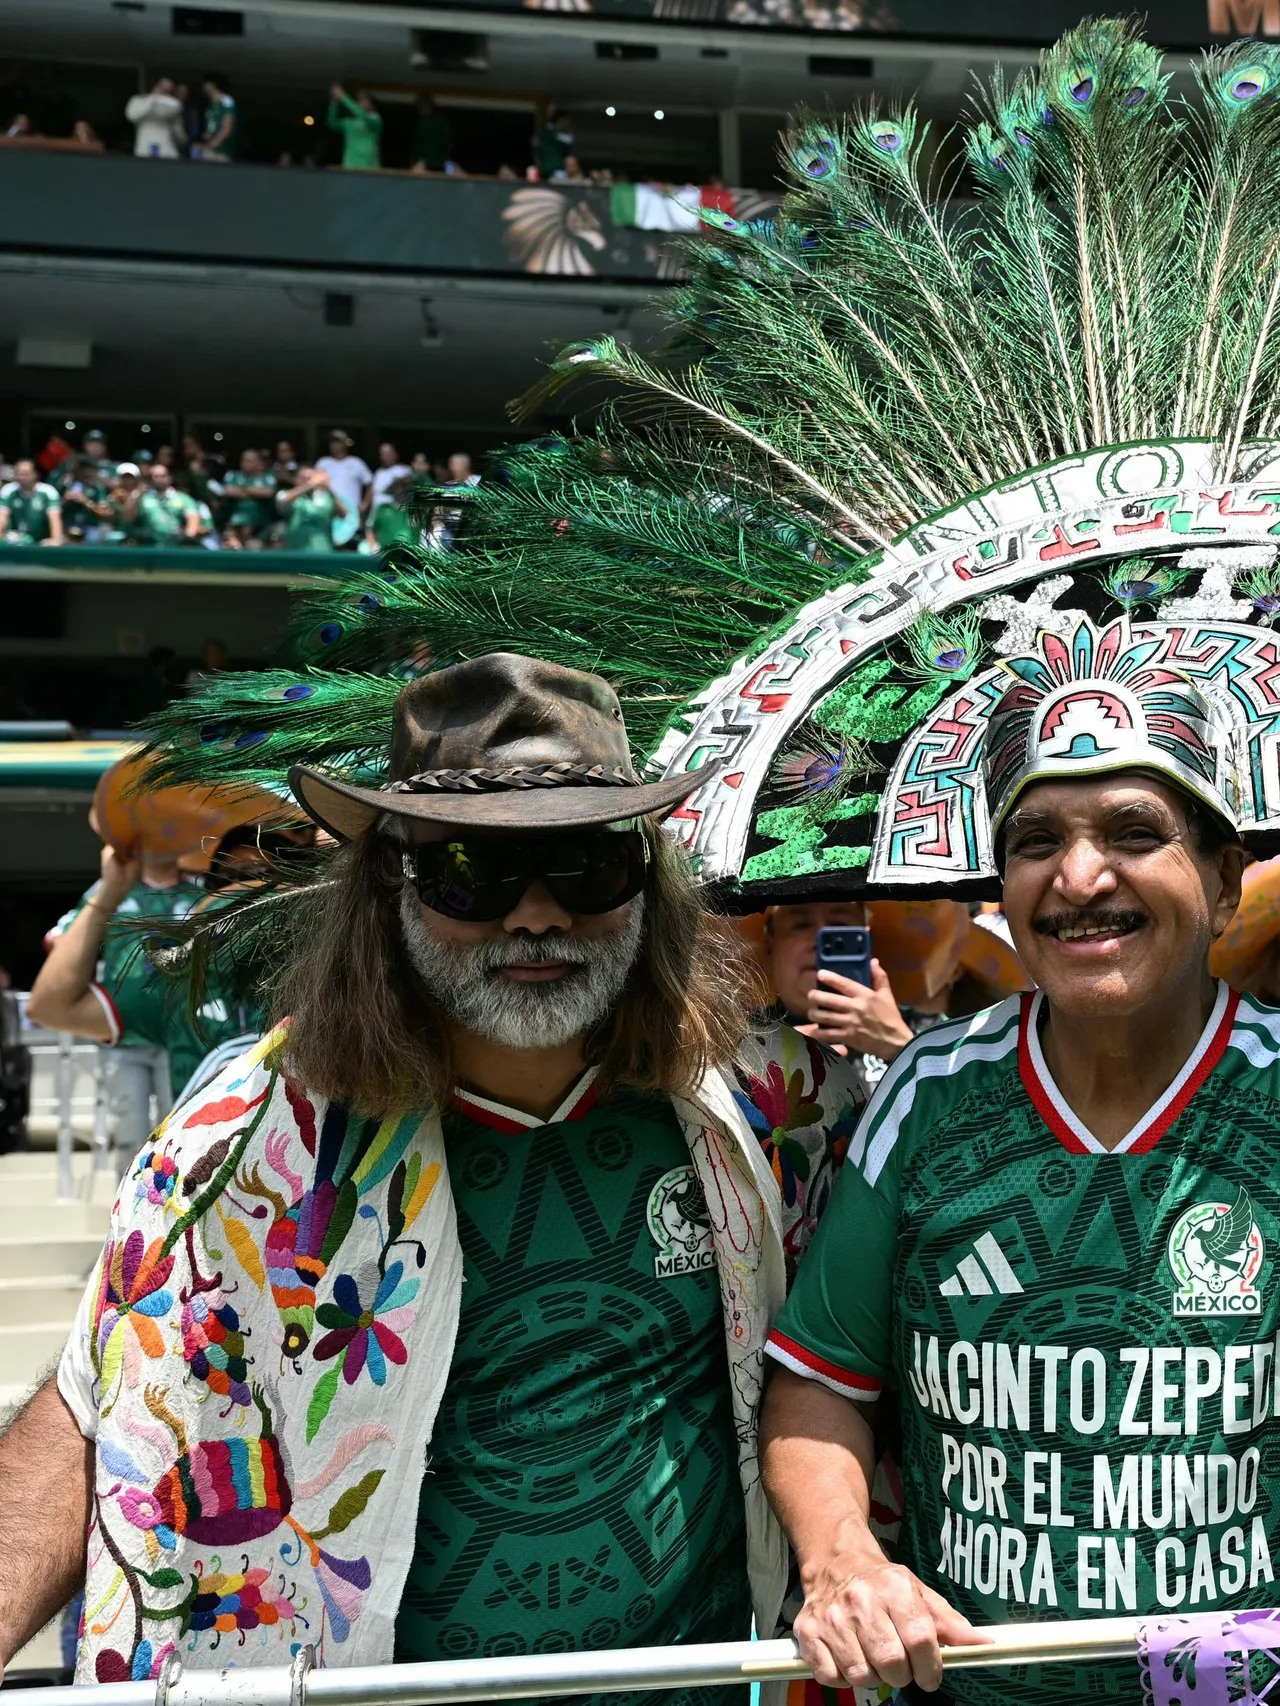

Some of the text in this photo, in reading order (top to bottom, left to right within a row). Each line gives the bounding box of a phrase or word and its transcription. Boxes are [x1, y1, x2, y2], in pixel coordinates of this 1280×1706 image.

[1176, 1292, 1259, 1312] MÉXICO
[908, 1331, 1107, 1435] JACINTO
[941, 1433, 1261, 1530] POR EL MUNDO
[936, 1506, 1275, 1610] AHORA EN CASA
